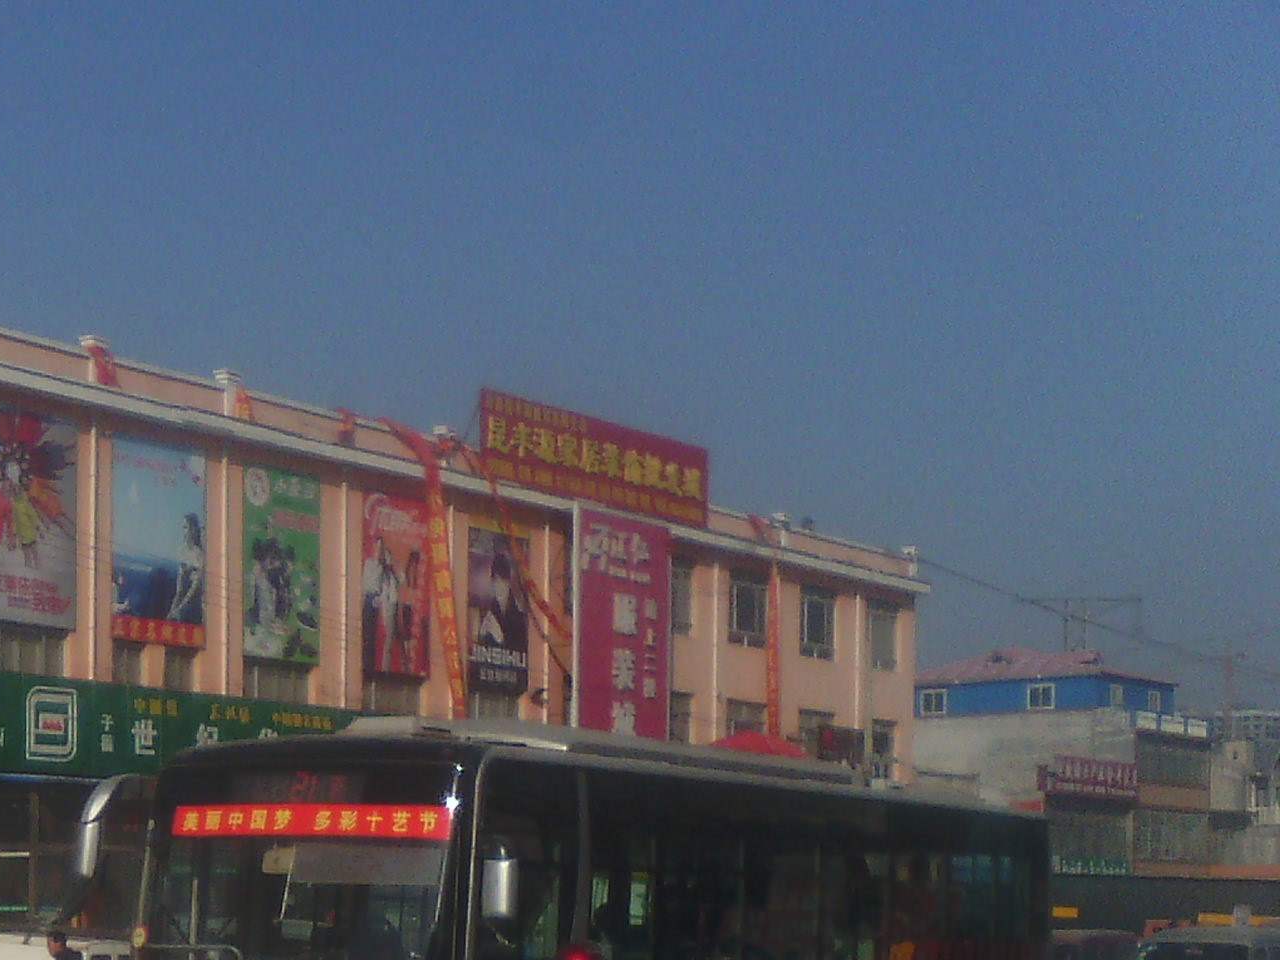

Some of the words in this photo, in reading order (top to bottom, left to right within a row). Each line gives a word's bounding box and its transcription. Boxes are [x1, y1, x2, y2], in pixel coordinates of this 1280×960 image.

[313, 810, 439, 833] 多彩十艺节
